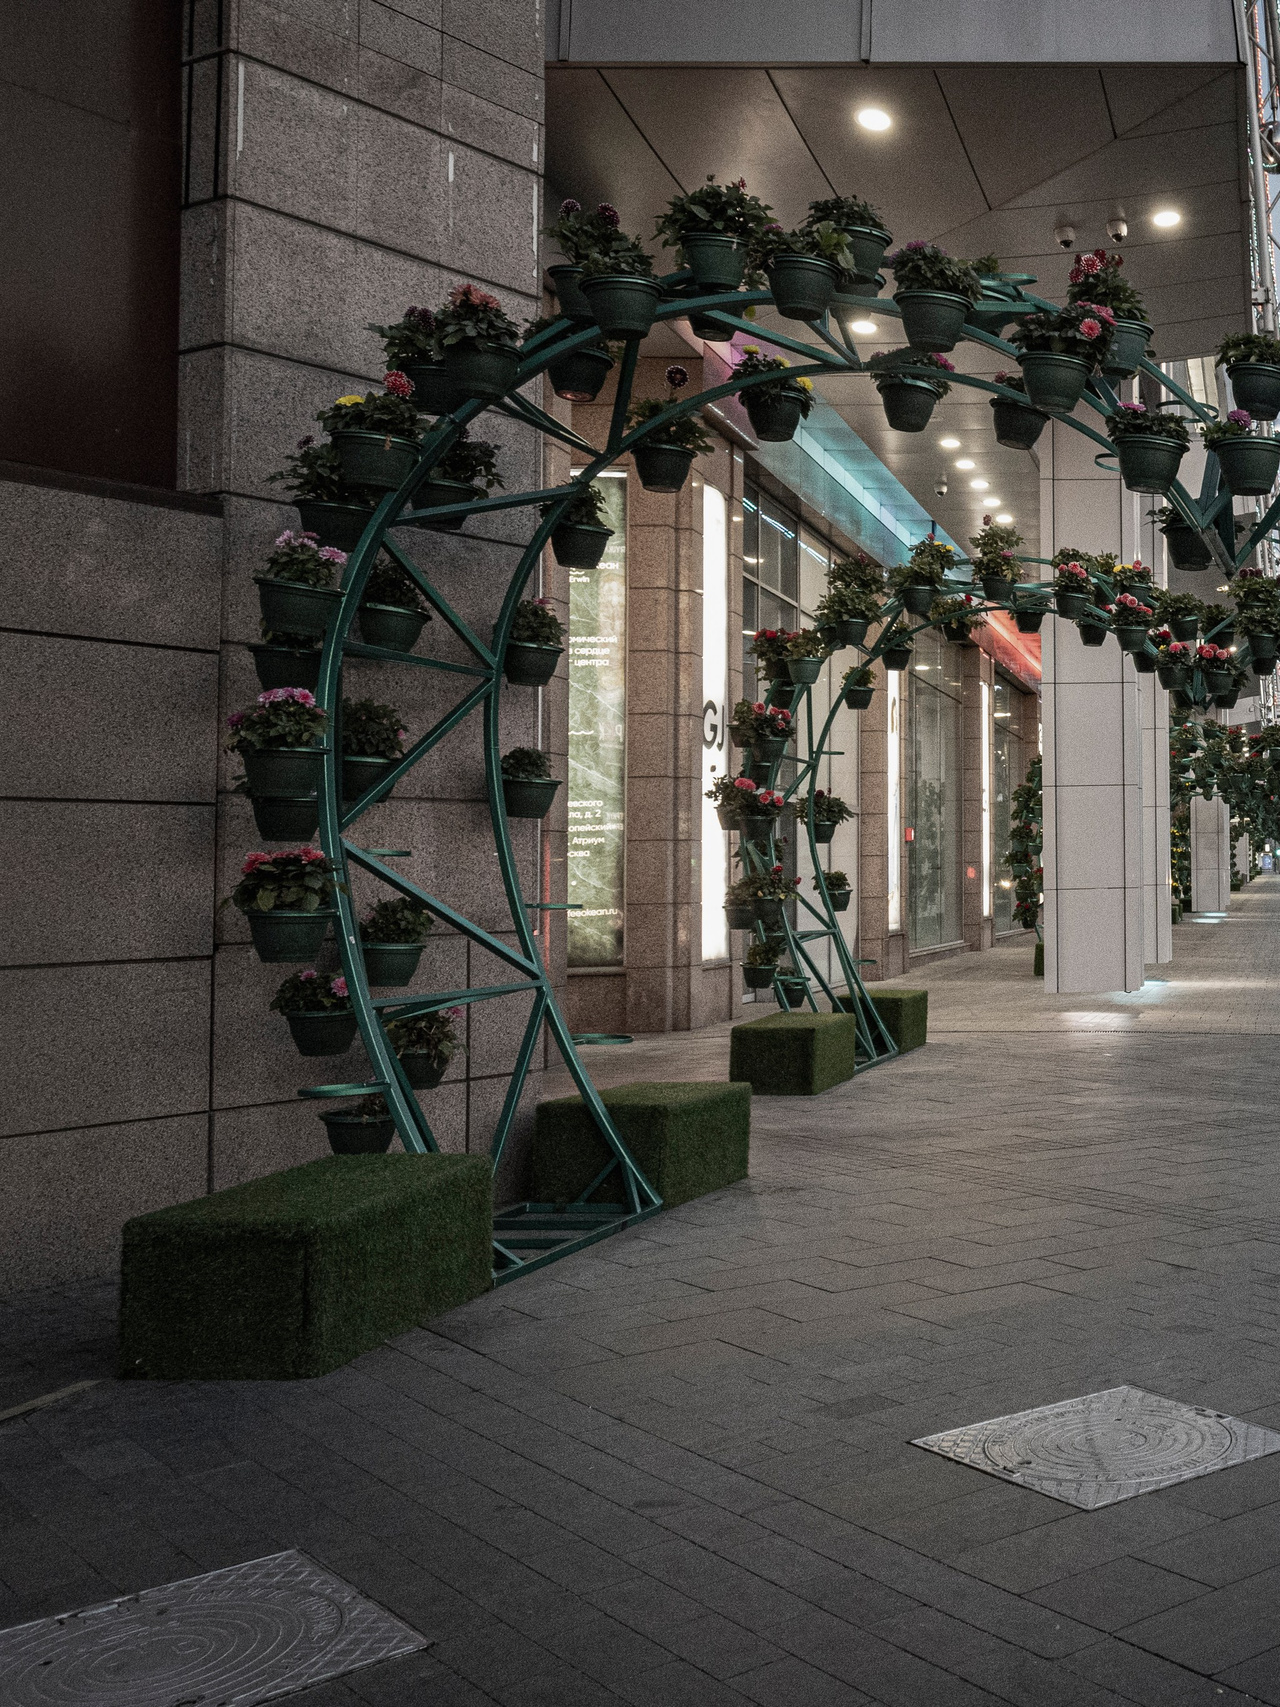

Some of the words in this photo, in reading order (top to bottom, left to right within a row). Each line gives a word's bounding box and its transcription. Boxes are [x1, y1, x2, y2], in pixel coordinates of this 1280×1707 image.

[574, 648, 610, 656] сердце
[574, 659, 610, 667] центра
[703, 700, 725, 752] GJ
[595, 809, 602, 817] 2
[572, 836, 605, 846] Атриум
